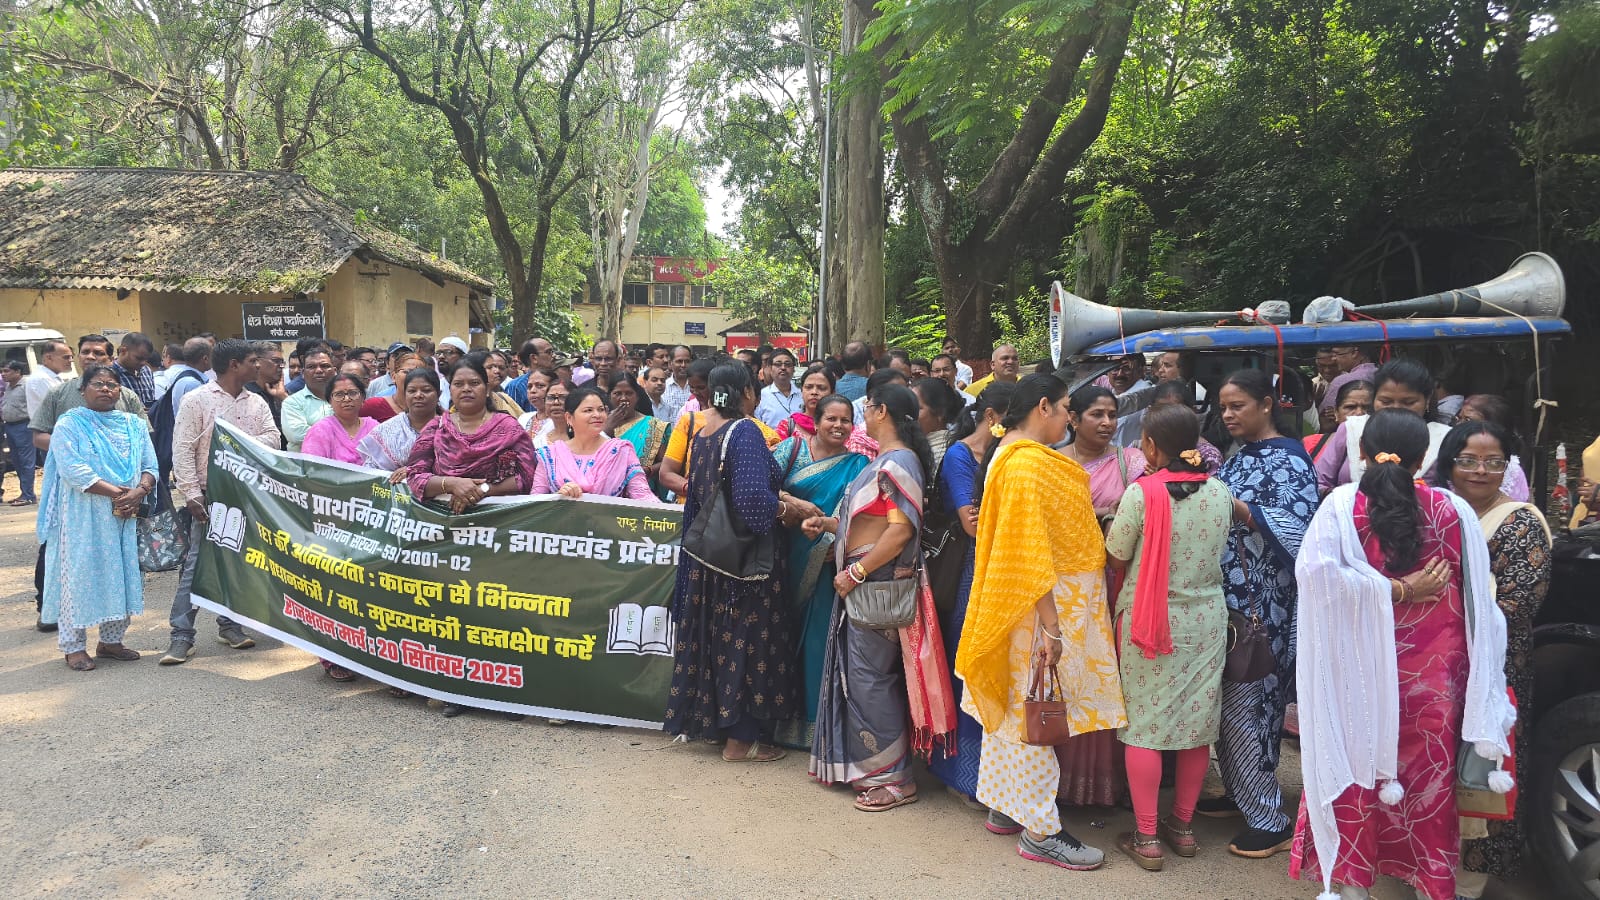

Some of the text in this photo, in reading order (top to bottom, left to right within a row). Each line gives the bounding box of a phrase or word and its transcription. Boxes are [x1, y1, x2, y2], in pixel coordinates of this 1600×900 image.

[248, 312, 320, 327] क्षेत्र शिक्षा पदाधिकारी
[265, 304, 294, 312] कार्यालय
[214, 450, 680, 566] अखिल झारखंड प्राथमिक शिक्षक संघ, झारखंड प्रदेश
[616, 516, 676, 532] राष्ट्र निर्माण
[313, 520, 352, 544] पंजीयन
[273, 530, 291, 556] की
[291, 543, 364, 584] अनिवार्यता
[378, 572, 444, 607] कानून
[448, 580, 472, 605] से
[476, 582, 572, 618] भिन्नता
[283, 593, 338, 640] राजभवन
[336, 626, 367, 652] मार्च
[376, 637, 400, 663] 20
[400, 638, 466, 678] सितंबर
[466, 658, 524, 688] 2025
[326, 590, 334, 606] /
[336, 592, 364, 618] मा.
[366, 603, 461, 641] मुख्यमंत्री
[466, 624, 550, 656] हस्तक्षेप
[554, 634, 596, 661] करें
